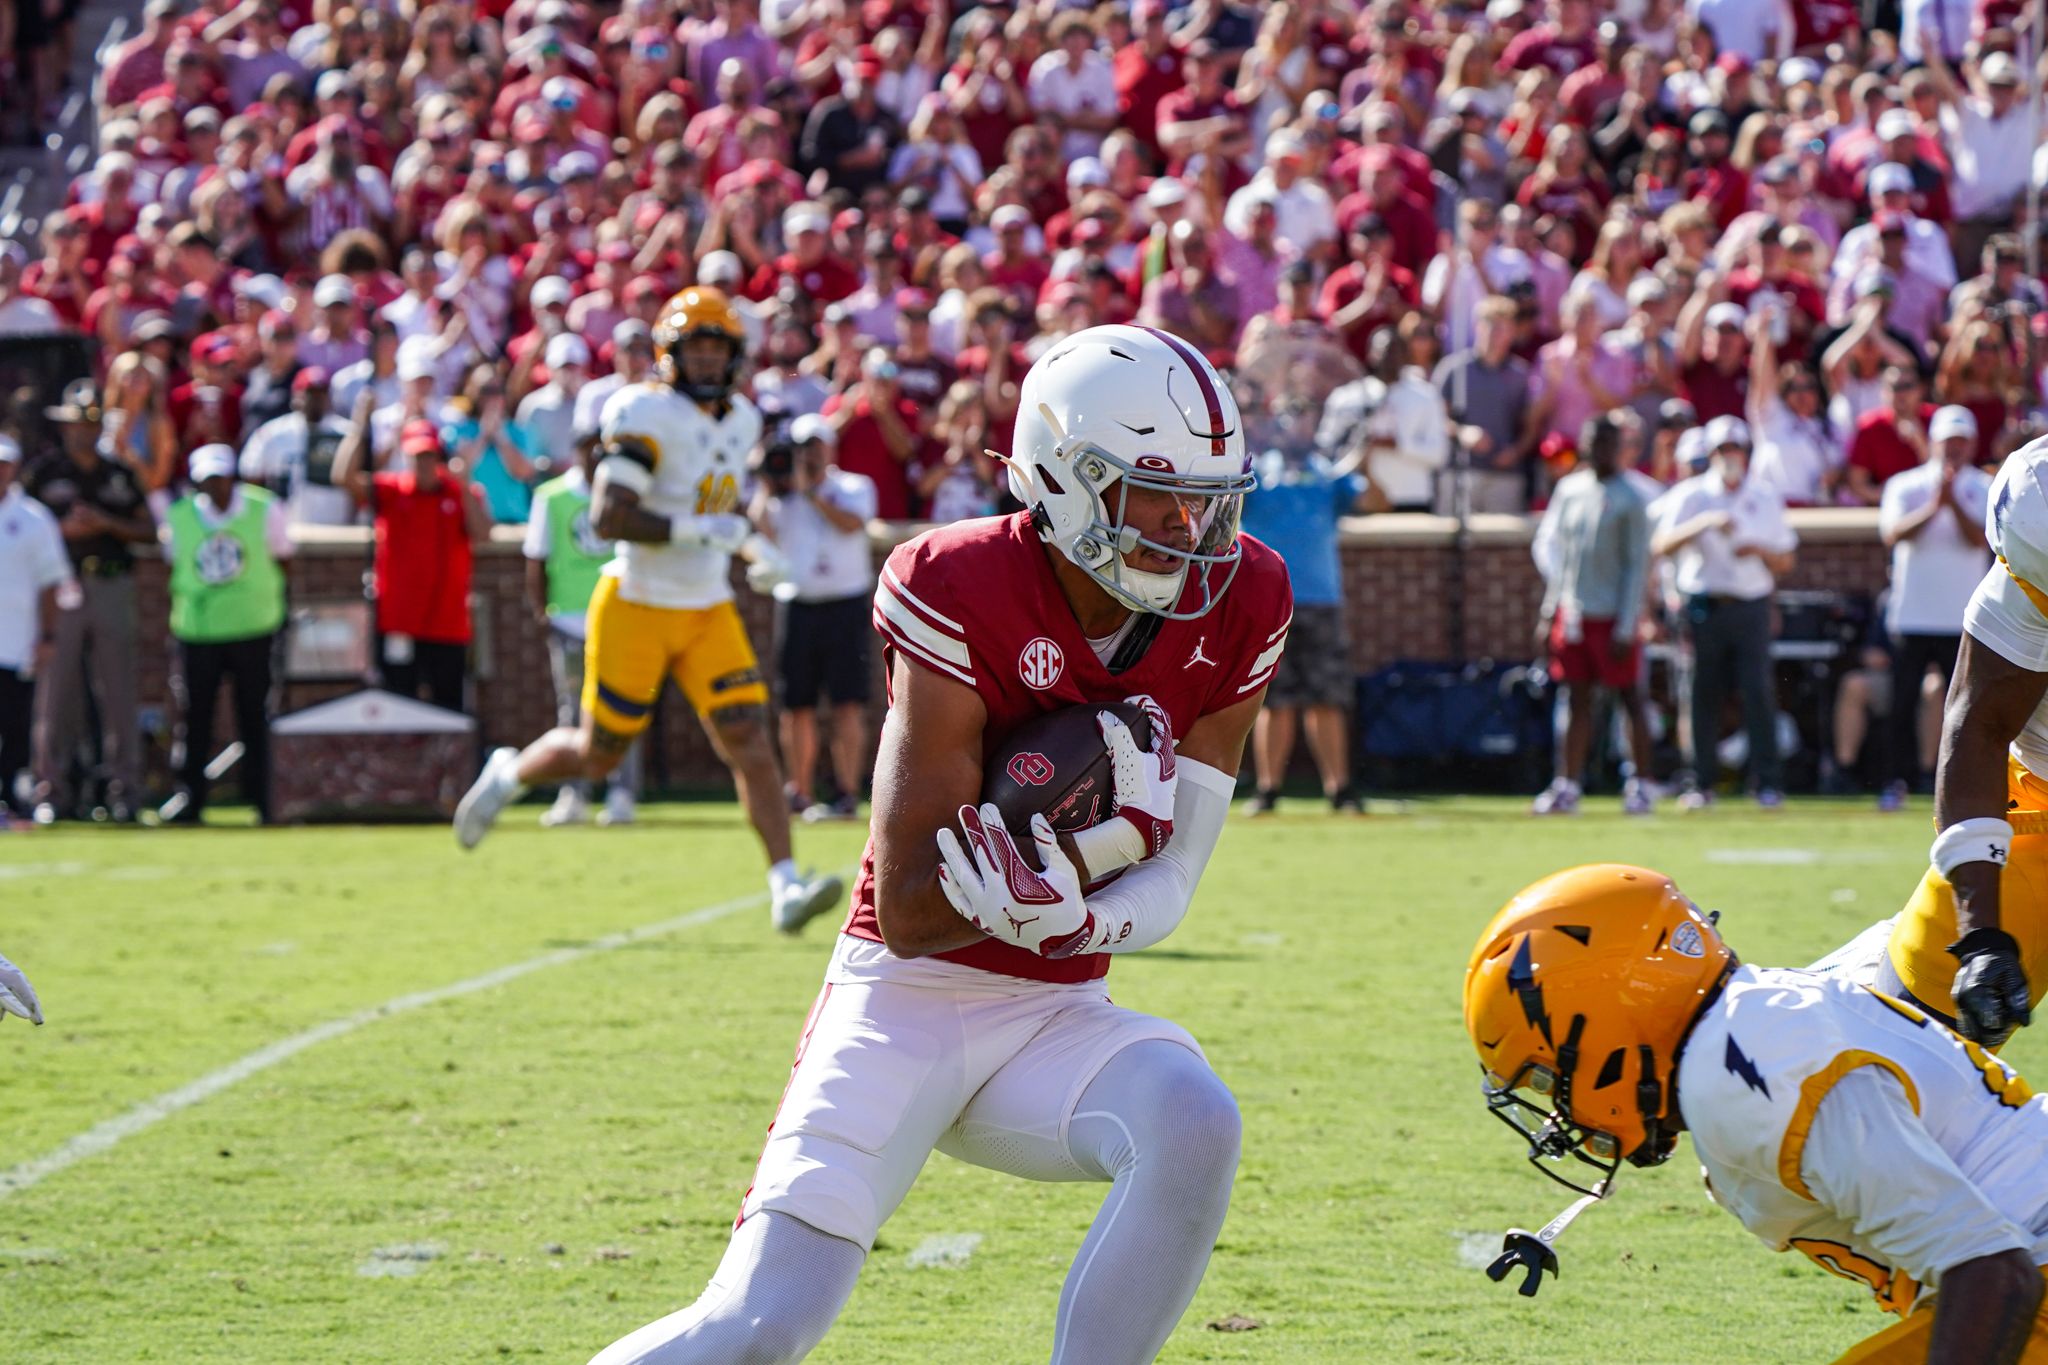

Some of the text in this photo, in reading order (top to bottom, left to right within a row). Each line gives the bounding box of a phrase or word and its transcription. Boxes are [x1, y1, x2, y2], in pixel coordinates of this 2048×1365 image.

[695, 472, 738, 515] 10
[1023, 640, 1060, 687] SEC
[1006, 751, 1055, 787] OU
[1047, 776, 1095, 824] FLYELIT
